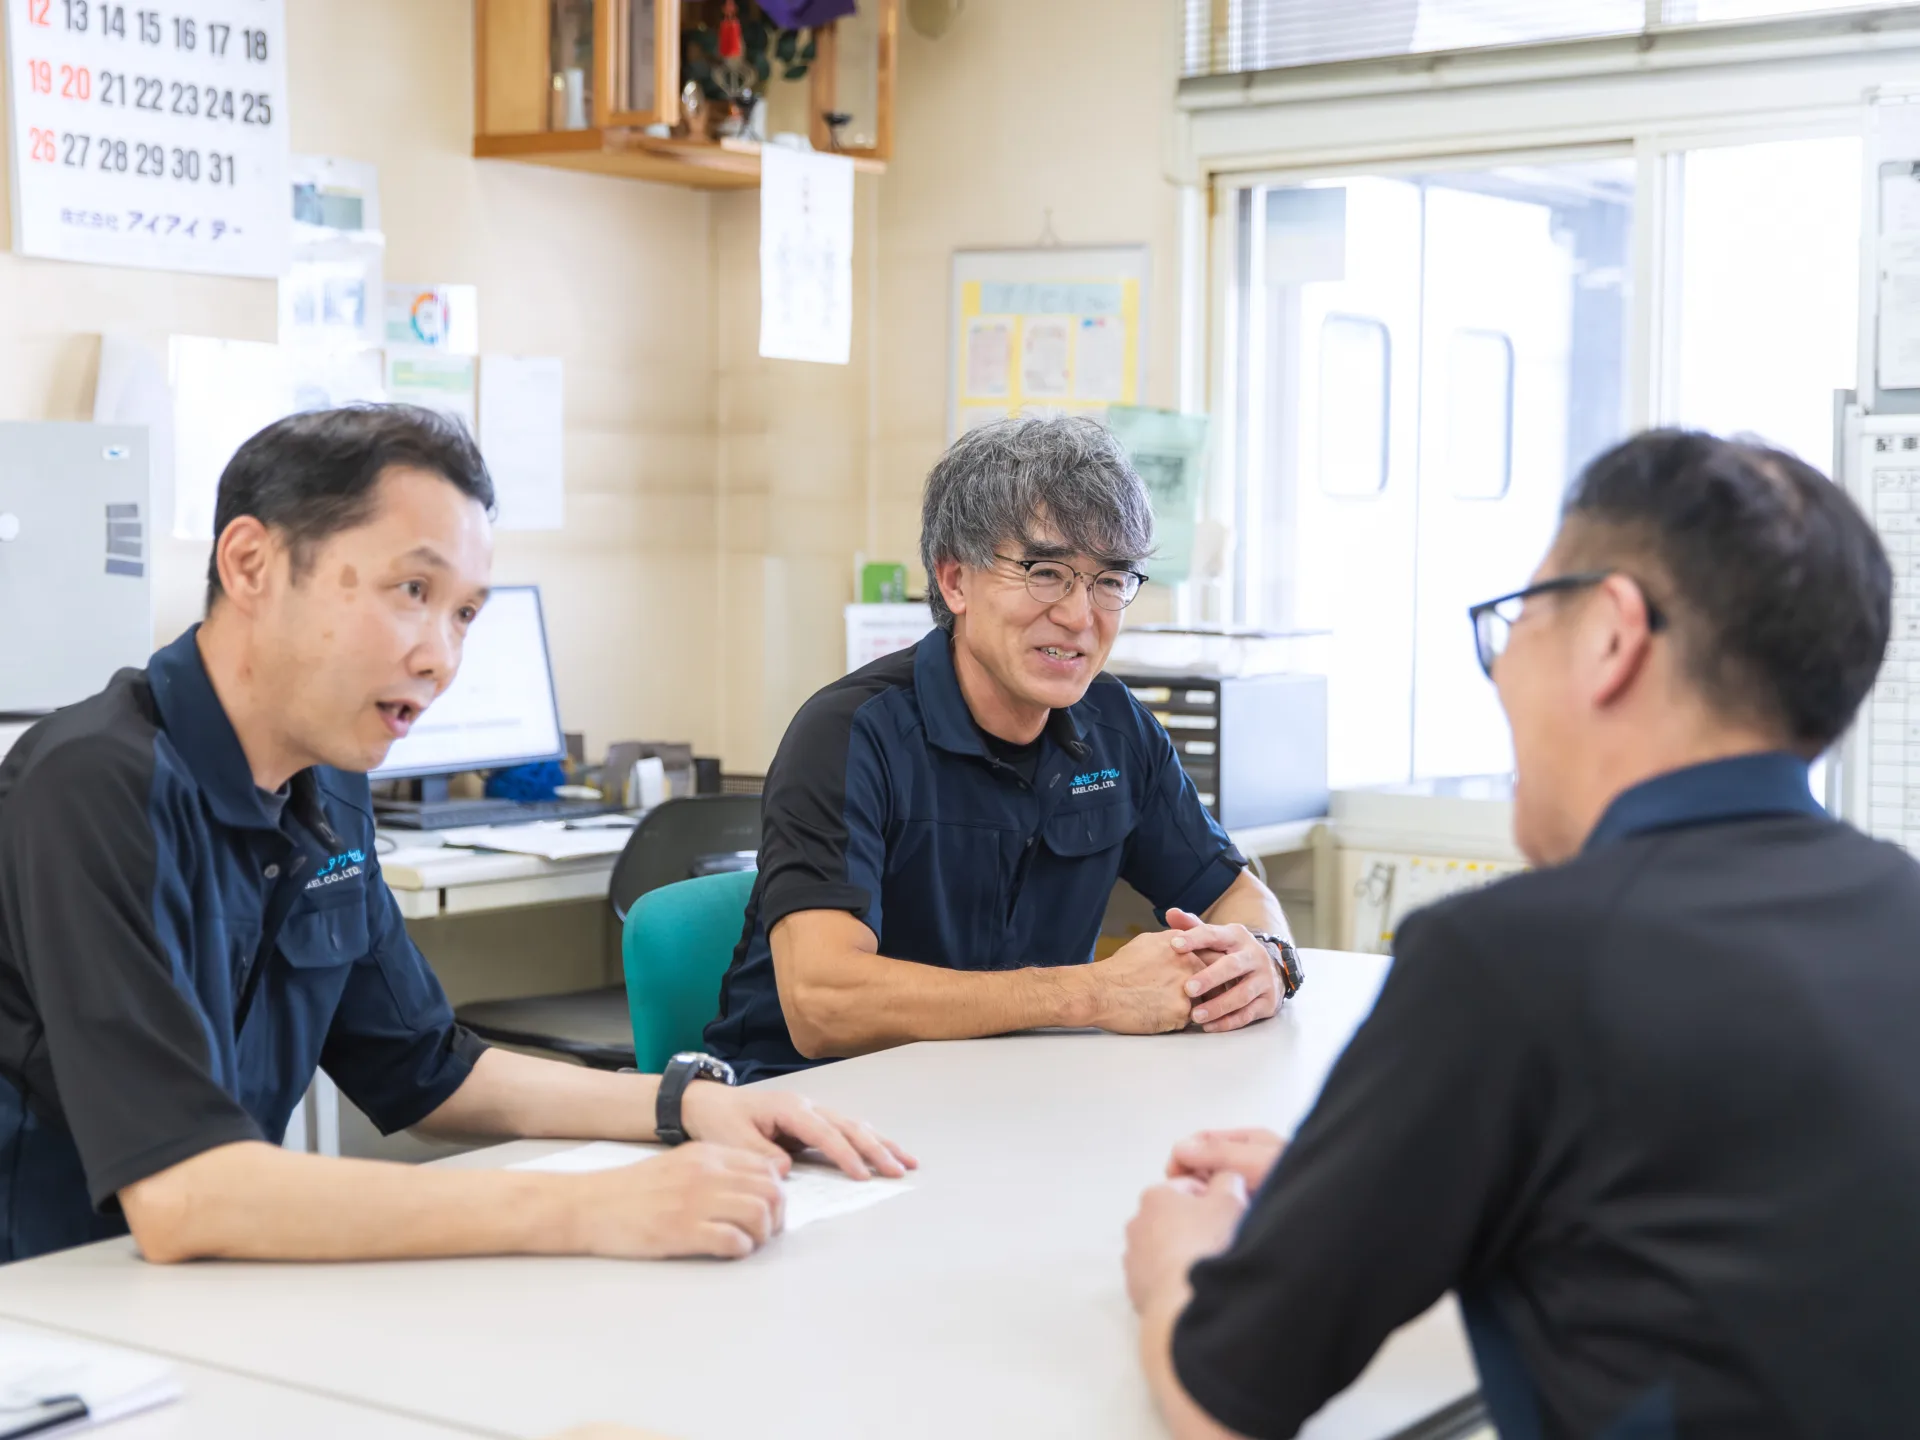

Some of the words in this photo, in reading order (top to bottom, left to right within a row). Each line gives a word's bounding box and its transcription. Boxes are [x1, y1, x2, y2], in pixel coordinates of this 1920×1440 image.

[28, 0, 50, 26] 12
[62, 0, 89, 32] 13
[99, 3, 126, 39] 14
[136, 10, 162, 45] 15
[172, 16, 197, 51] 16
[207, 22, 231, 57] 17
[242, 28, 268, 63] 18
[28, 59, 52, 94] 19
[60, 64, 90, 101] 20
[99, 70, 126, 106] 21
[134, 76, 164, 112] 22
[170, 81, 200, 117] 23
[204, 86, 236, 121] 24
[241, 91, 272, 126] 25
[29, 126, 56, 163] 26
[62, 132, 91, 168] 27
[99, 137, 128, 173] 28
[135, 142, 164, 177] 29
[171, 147, 200, 182] 30
[209, 152, 235, 186] 31
[1069, 768, 1119, 786] 会社アクセル
